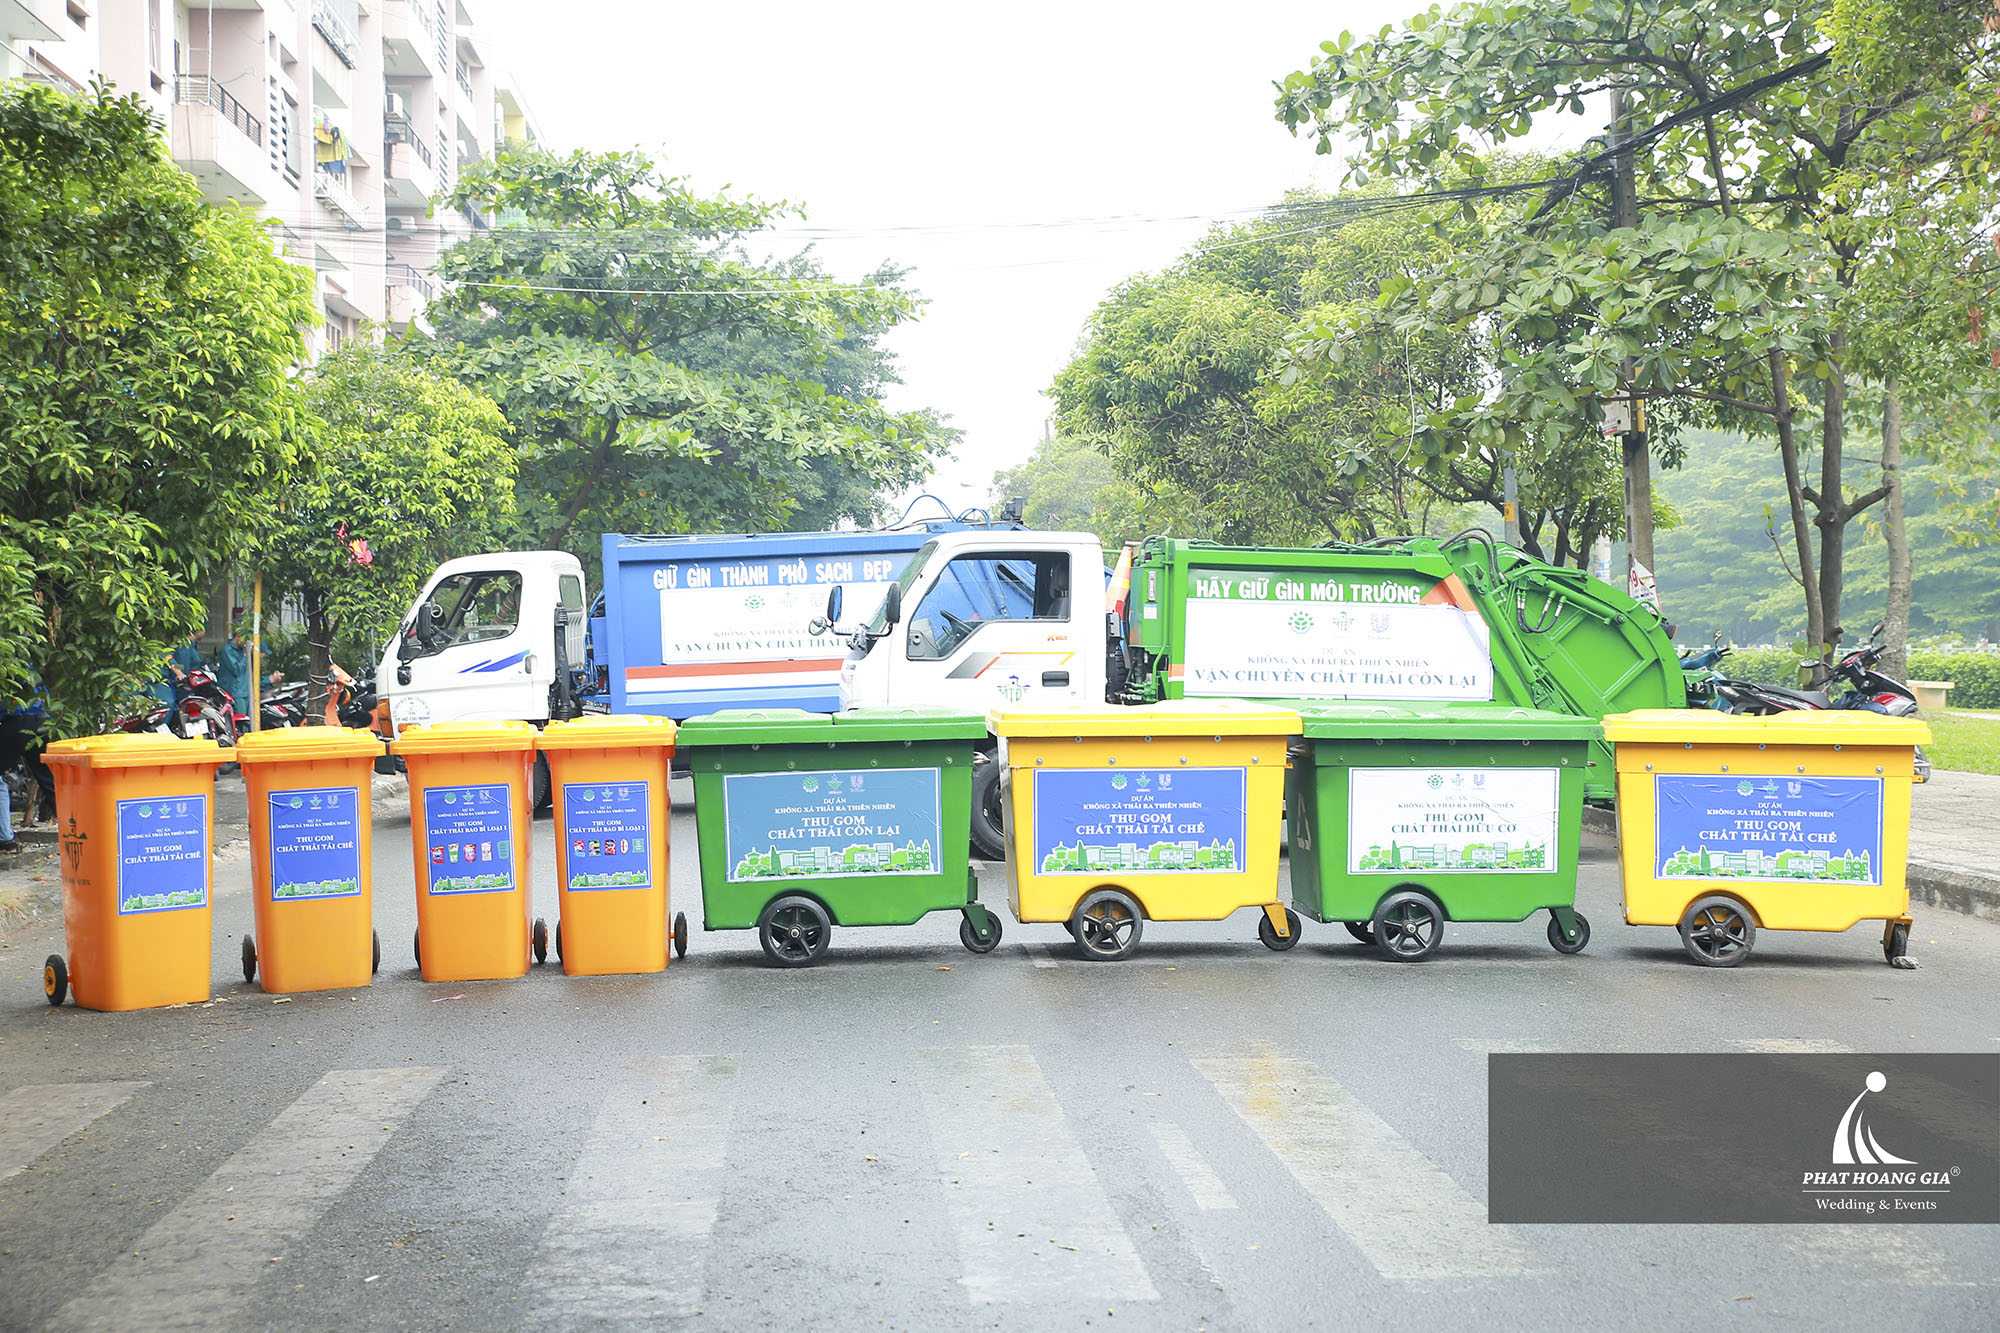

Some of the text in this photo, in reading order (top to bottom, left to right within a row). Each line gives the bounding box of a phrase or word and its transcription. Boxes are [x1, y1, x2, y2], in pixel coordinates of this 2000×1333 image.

[654, 558, 893, 589] GIỮ GÌN THÀNH PHỐ SẠCH ĐẸP
[1196, 576, 1420, 604] HÃY GIỮ GÌN MÔI TRƯỜNG
[802, 816, 865, 827] THU GOM
[1110, 814, 1172, 823] THU GOM
[1424, 813, 1484, 822] THU GOM
[1735, 820, 1801, 831] THU GOM
